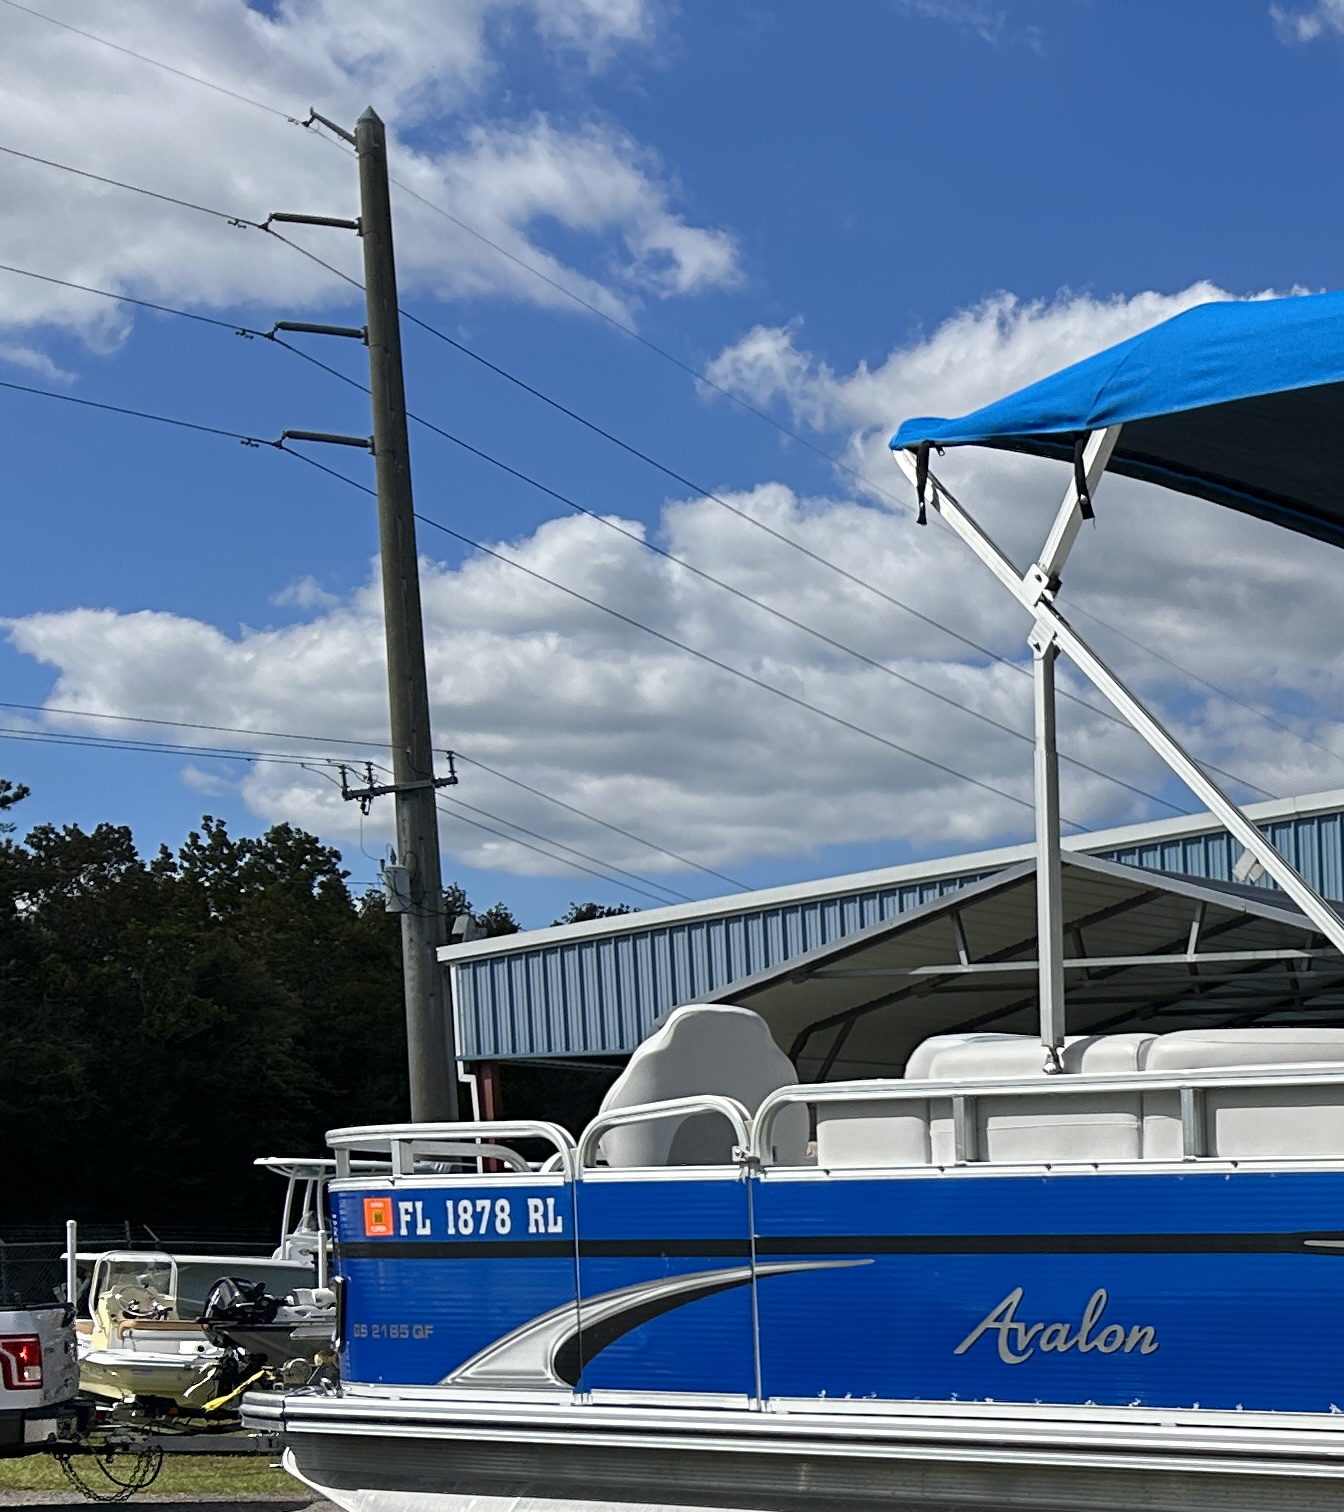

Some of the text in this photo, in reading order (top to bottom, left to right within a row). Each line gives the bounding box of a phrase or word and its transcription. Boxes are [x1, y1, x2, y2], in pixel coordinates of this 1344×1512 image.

[398, 1197, 563, 1236] FL 1878 RL
[371, 1323, 409, 1338] 2185
[953, 1286, 1159, 1365] Avalon
